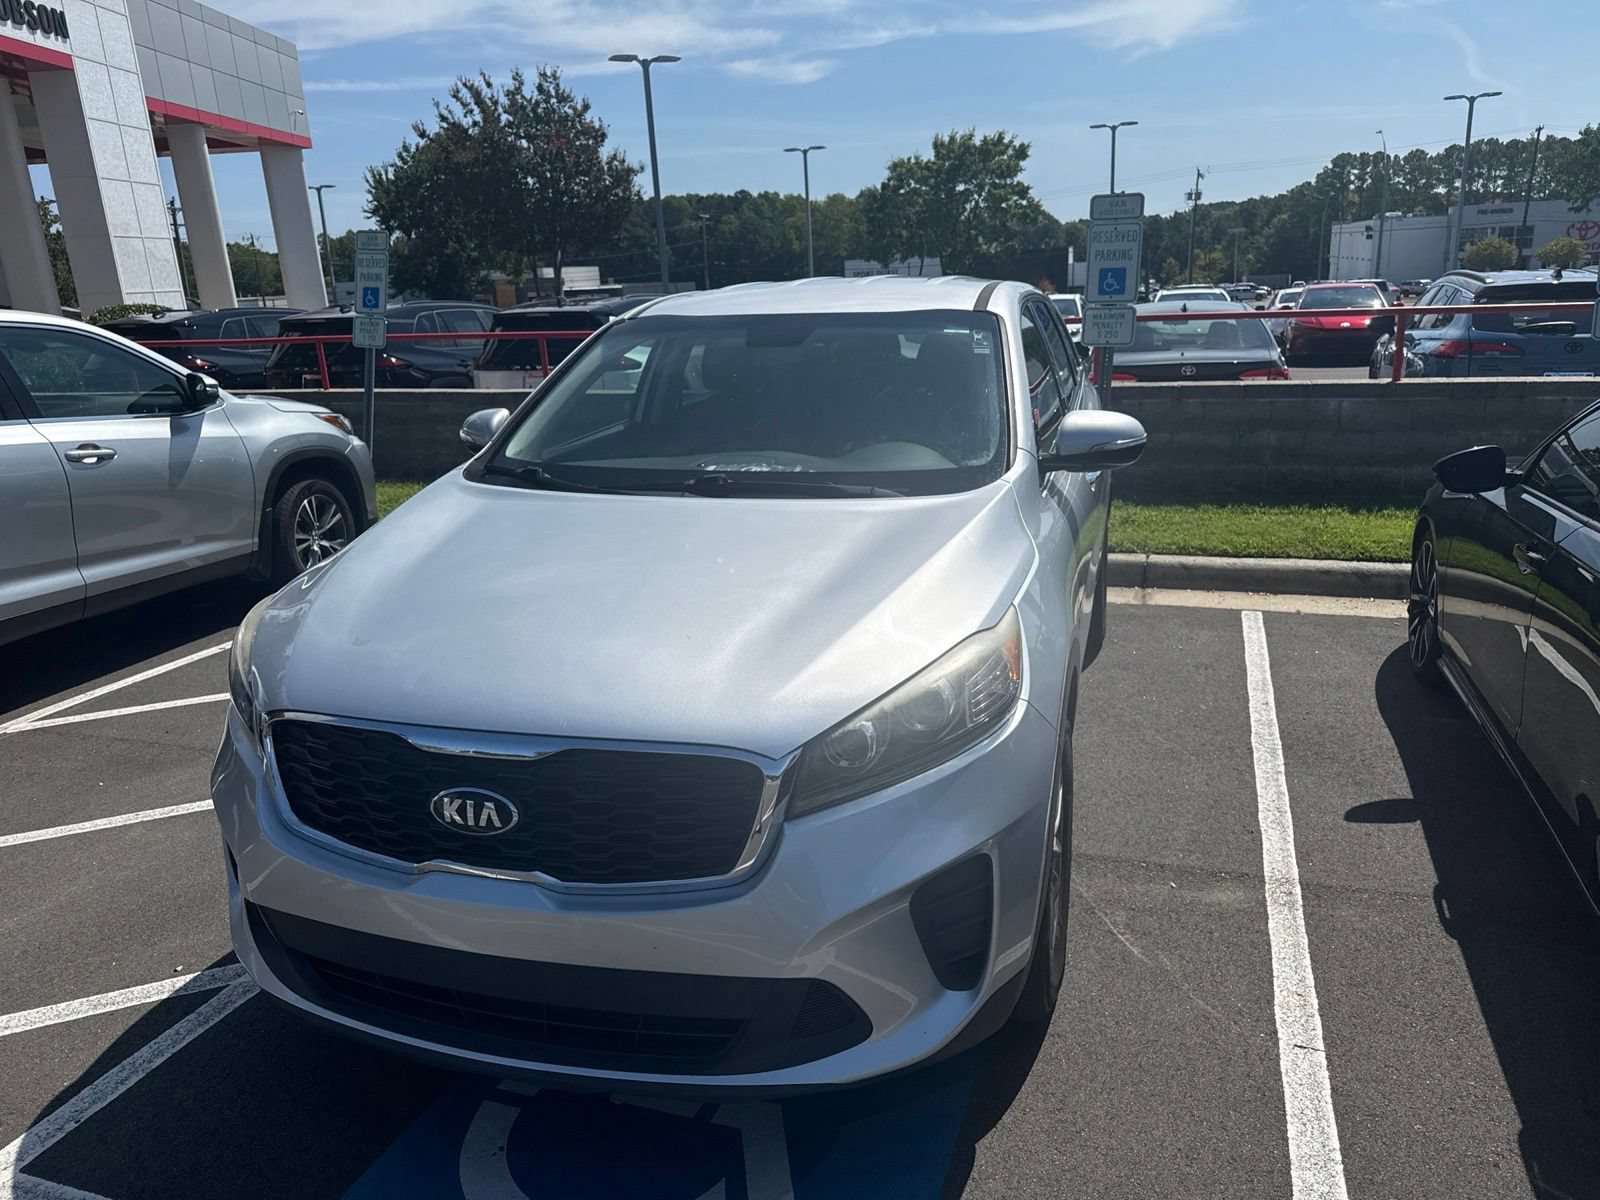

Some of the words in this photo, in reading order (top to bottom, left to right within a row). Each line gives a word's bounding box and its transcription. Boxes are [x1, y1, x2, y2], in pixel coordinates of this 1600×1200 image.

[1109, 199, 1127, 208] VAN
[1092, 230, 1138, 243] RESERVED
[1094, 248, 1133, 262] PARKING
[358, 257, 385, 269] RESERVED
[360, 272, 383, 282] PARKING
[1092, 311, 1126, 320] MAXIMUM
[1092, 321, 1123, 330] PENALTY
[442, 797, 503, 828] KIA
